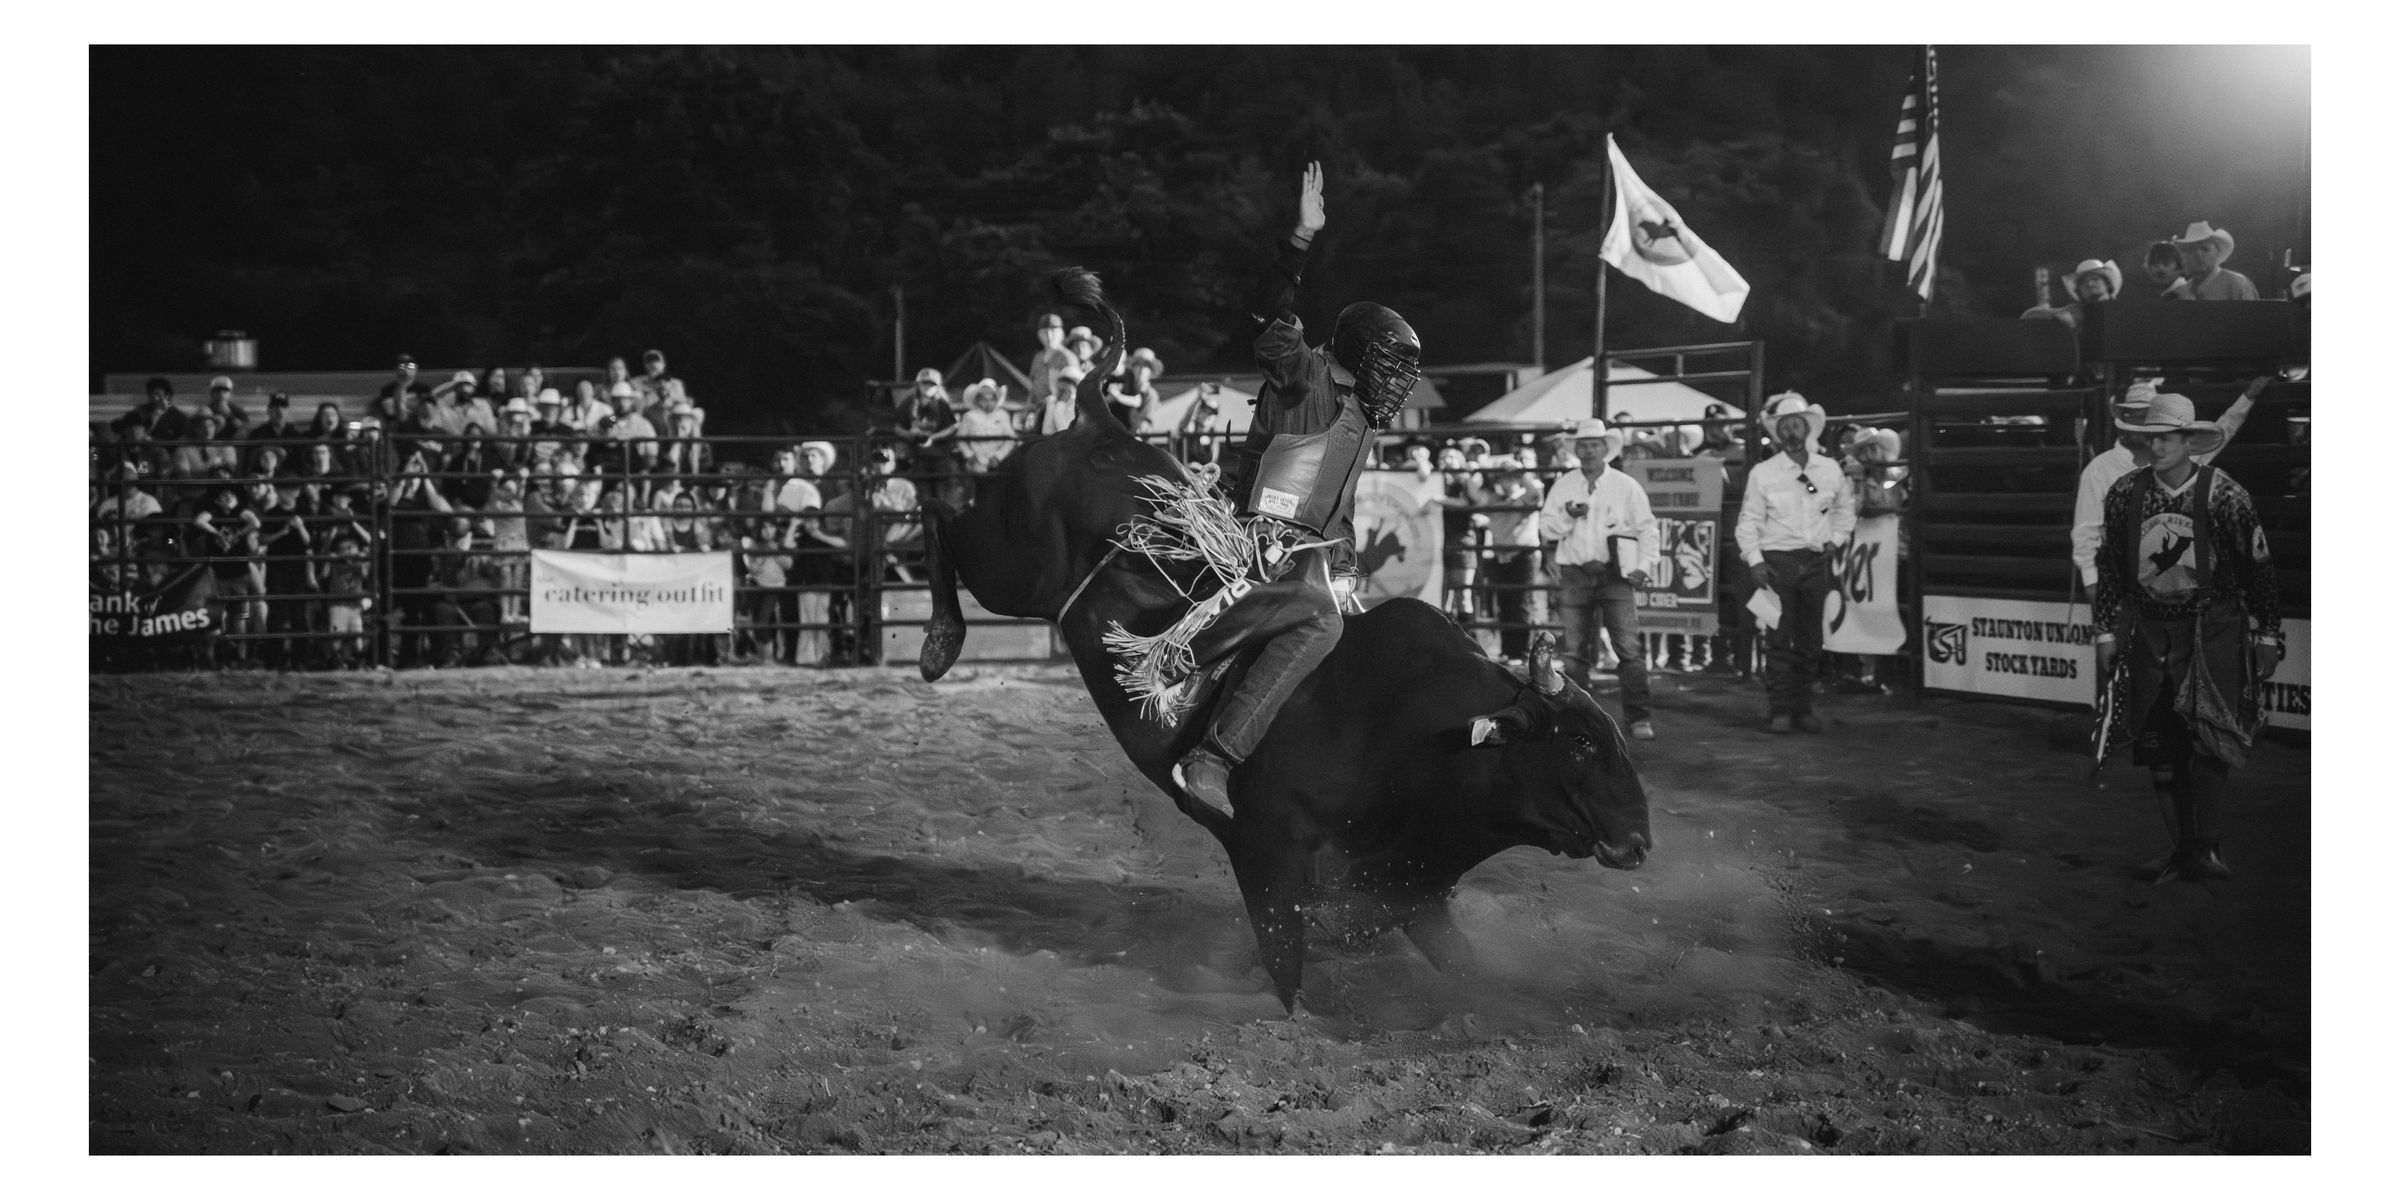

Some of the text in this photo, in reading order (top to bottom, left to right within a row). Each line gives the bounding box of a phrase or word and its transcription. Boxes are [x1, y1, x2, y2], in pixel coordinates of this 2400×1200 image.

[544, 581, 724, 610] catering outfit
[127, 607, 210, 636] James
[1971, 616, 2095, 647] STAUNTON UNION
